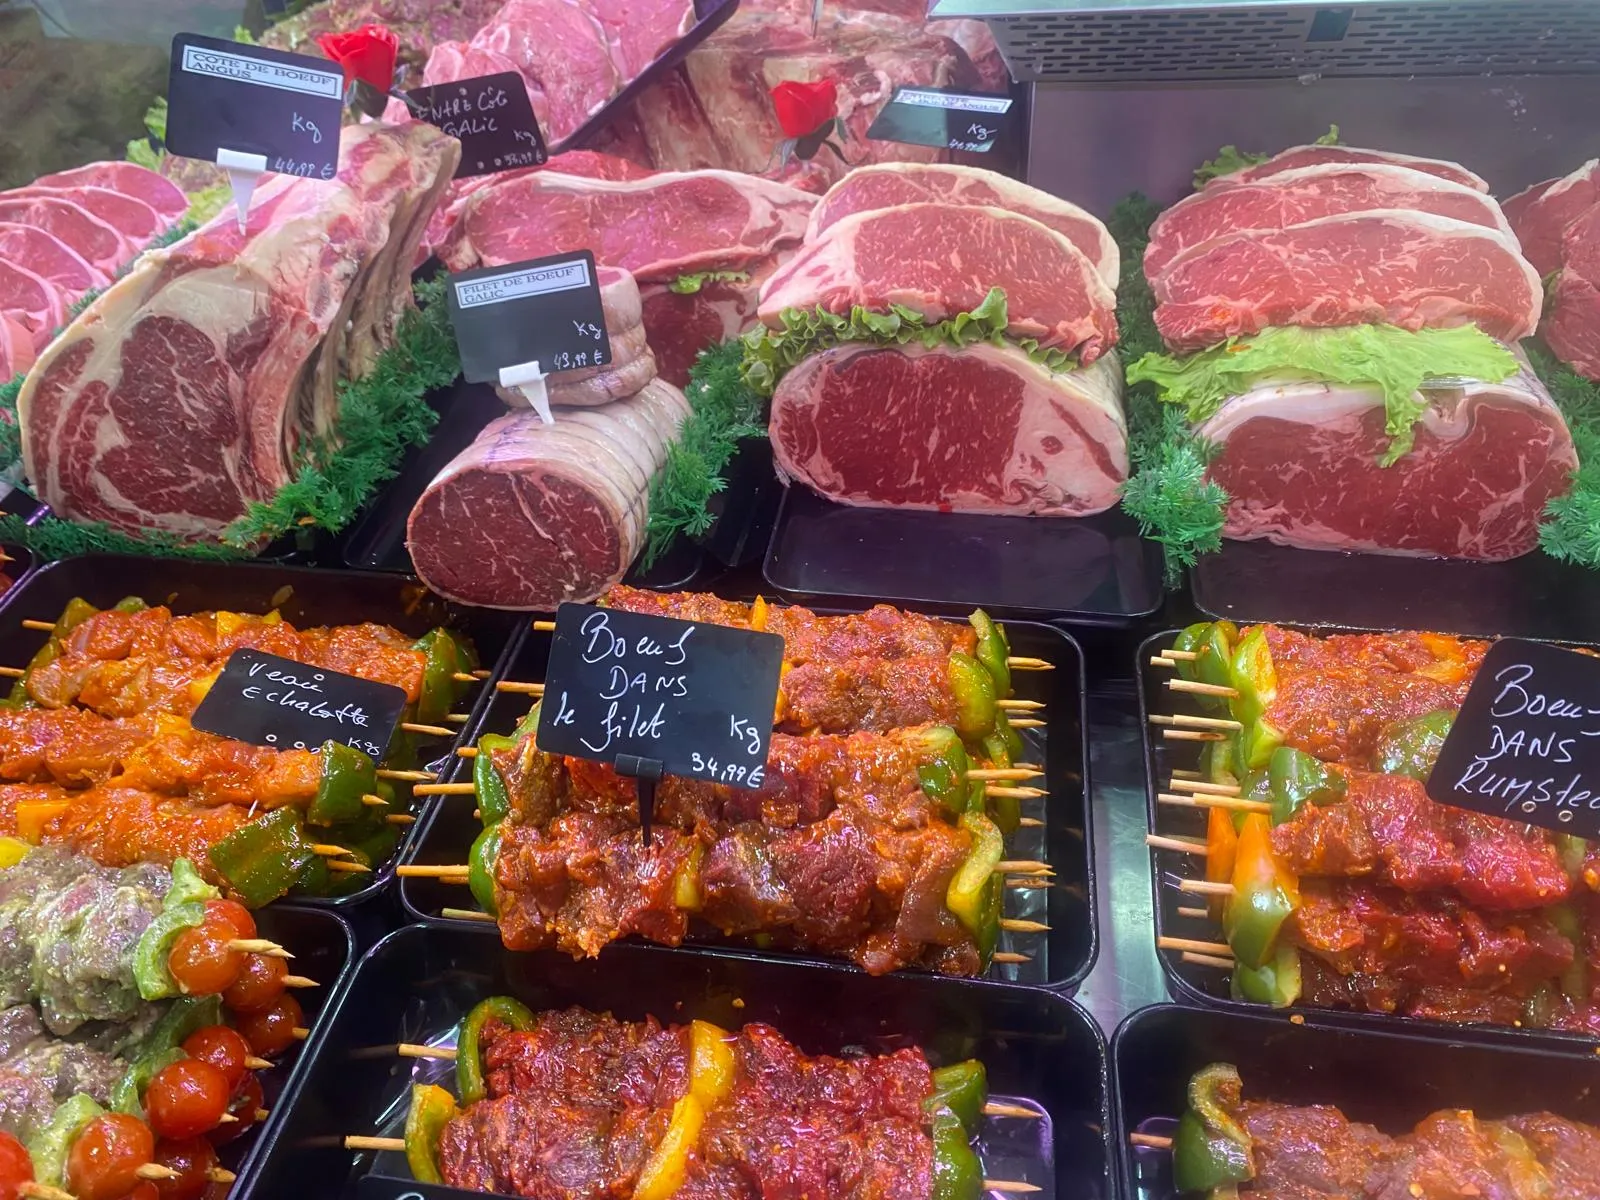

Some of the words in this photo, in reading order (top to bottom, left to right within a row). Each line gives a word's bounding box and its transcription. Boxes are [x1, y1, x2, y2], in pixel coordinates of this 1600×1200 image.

[193, 53, 240, 67] COTE
[245, 63, 269, 74] DE
[274, 69, 332, 85] BOEUF
[193, 61, 251, 78] ANGUS
[292, 112, 322, 143] Kg
[463, 281, 500, 296] FILET
[503, 277, 523, 287] DE
[526, 267, 576, 283] BOEUF
[464, 289, 504, 304] GALIC
[572, 320, 601, 339] Kg
[580, 611, 695, 665] Boeuf
[599, 665, 688, 700] DANS
[553, 691, 575, 726] le
[579, 701, 666, 753] filet
[730, 714, 761, 754] Kg
[1474, 725, 1576, 763] DANS
